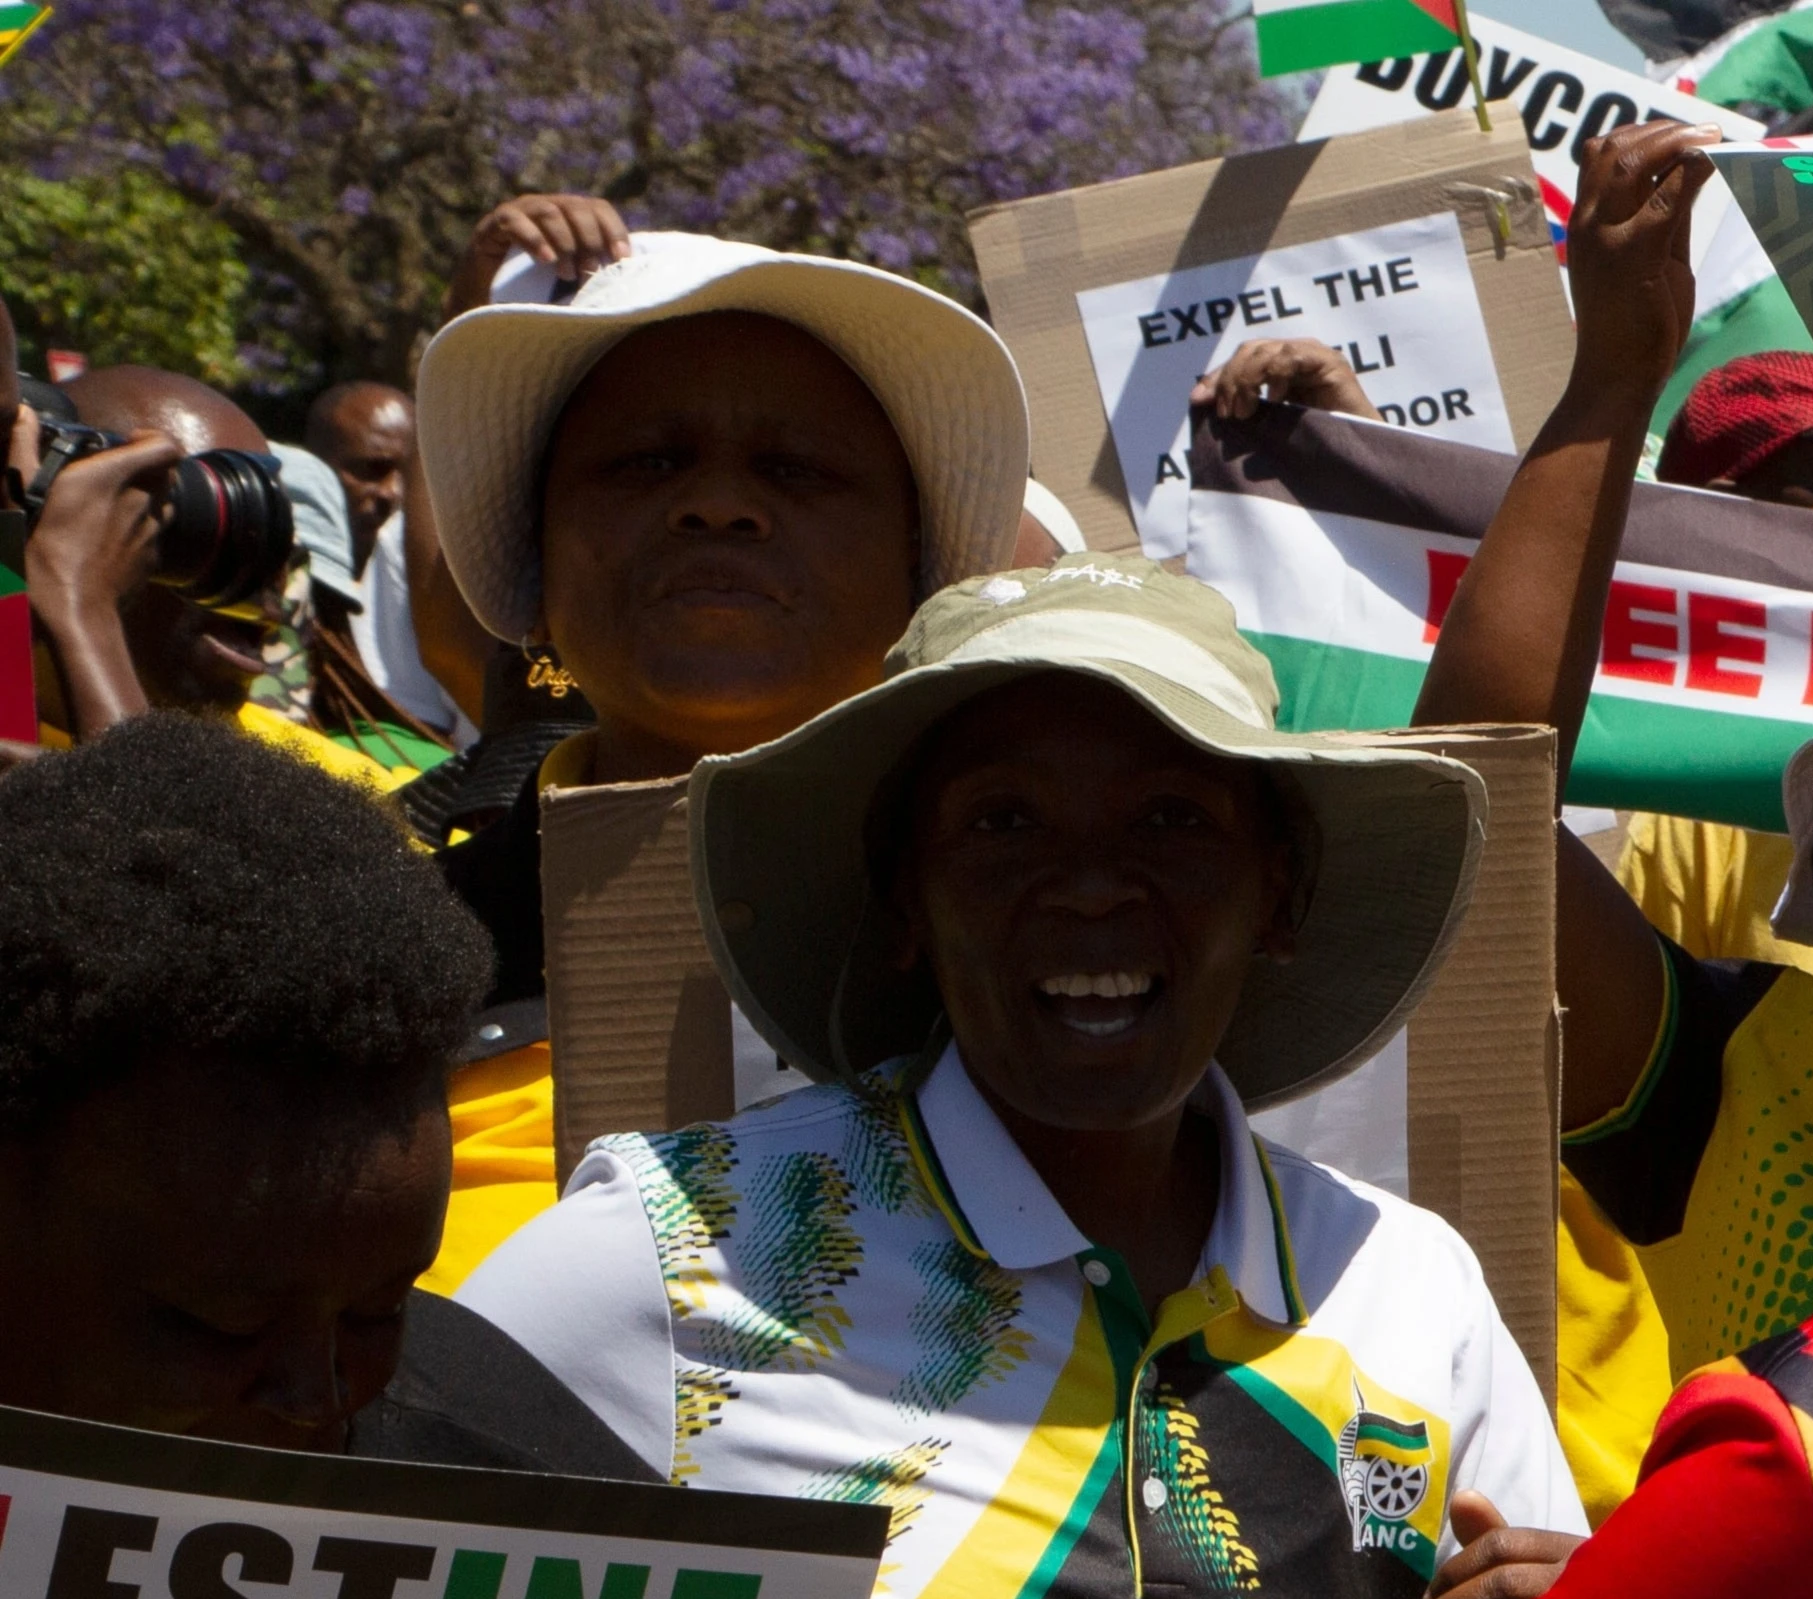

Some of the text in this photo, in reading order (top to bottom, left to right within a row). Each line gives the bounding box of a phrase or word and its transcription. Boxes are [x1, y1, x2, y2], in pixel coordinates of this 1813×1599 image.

[1137, 256, 1420, 350] EXPEL THE
[1361, 1523, 1419, 1551] ANC
